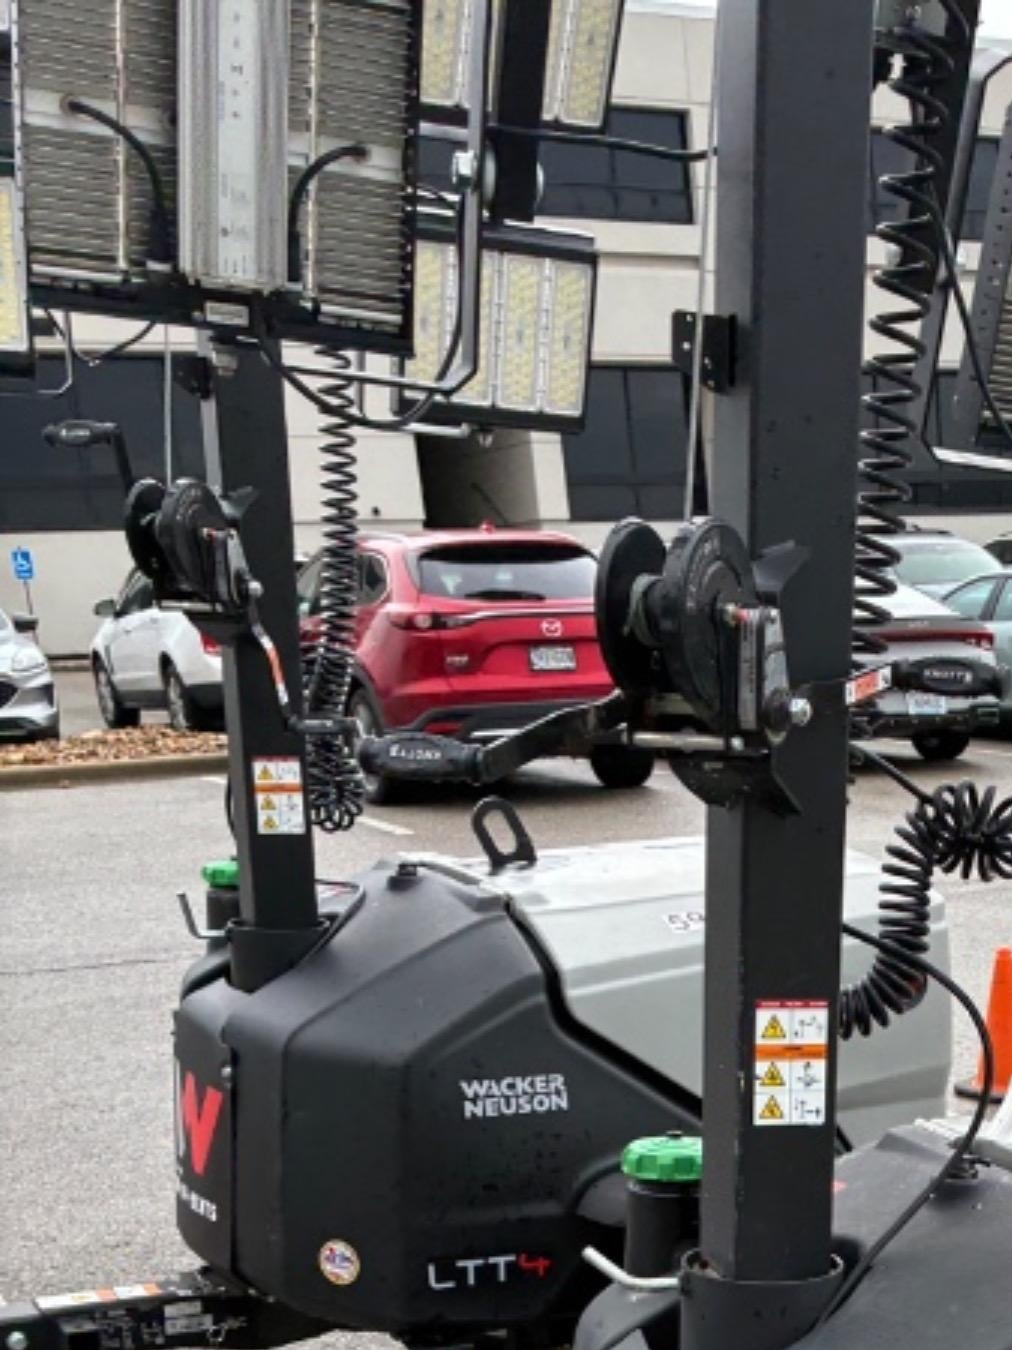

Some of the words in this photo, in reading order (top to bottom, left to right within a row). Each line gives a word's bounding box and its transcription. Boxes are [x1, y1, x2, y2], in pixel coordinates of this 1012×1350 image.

[460, 1073, 565, 1098] WACKER
[463, 1091, 569, 1118] NEUSON
[427, 1253, 550, 1290] LTT4
